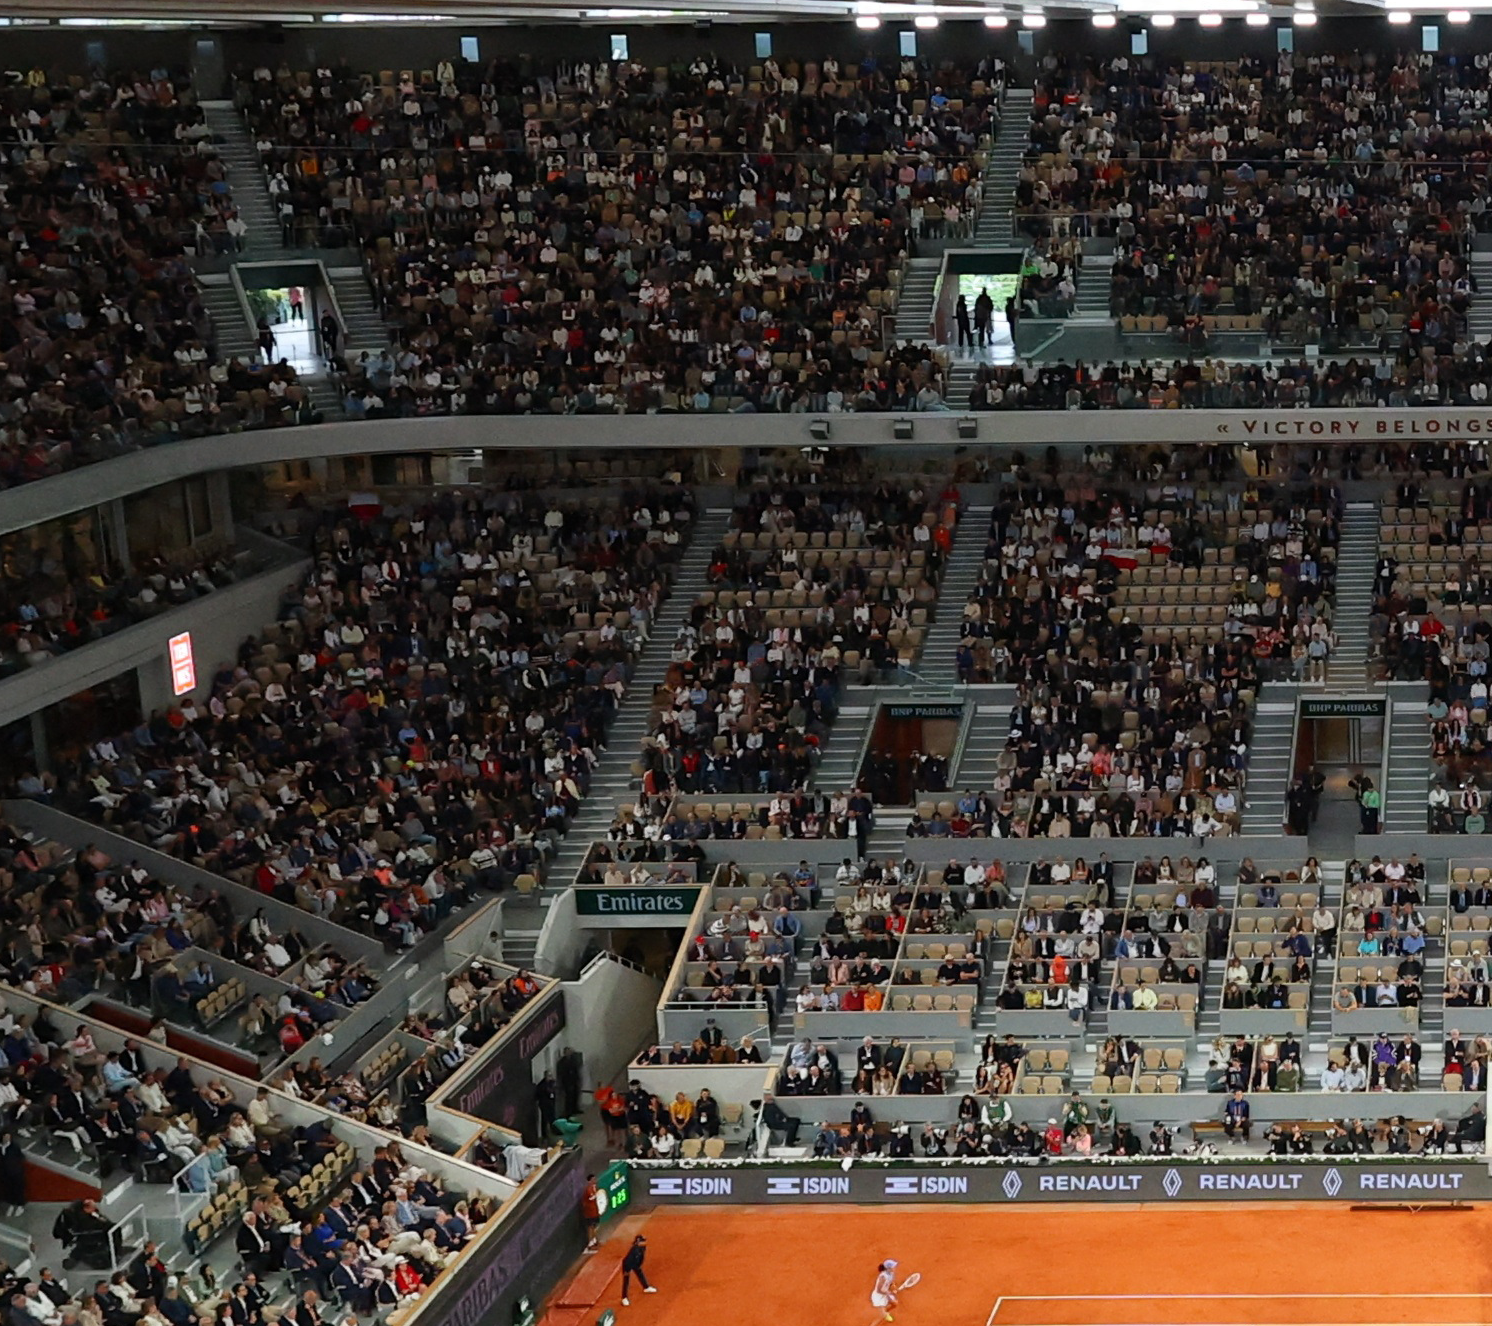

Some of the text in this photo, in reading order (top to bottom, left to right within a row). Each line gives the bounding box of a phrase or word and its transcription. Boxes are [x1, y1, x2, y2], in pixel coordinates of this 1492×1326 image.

[1243, 420, 1360, 435] VICTORY
[890, 706, 961, 717] BNP PARIBAS
[1308, 703, 1380, 713] BNP PARIBAS
[596, 890, 685, 915] Emirates
[685, 1177, 732, 1196] ISDIN
[802, 1177, 850, 1195] ISDIN
[920, 1177, 967, 1195] ISDIN
[1039, 1174, 1143, 1191] RENAULT
[1200, 1174, 1303, 1191] RENAULT
[1360, 1174, 1463, 1191] RENAULT
